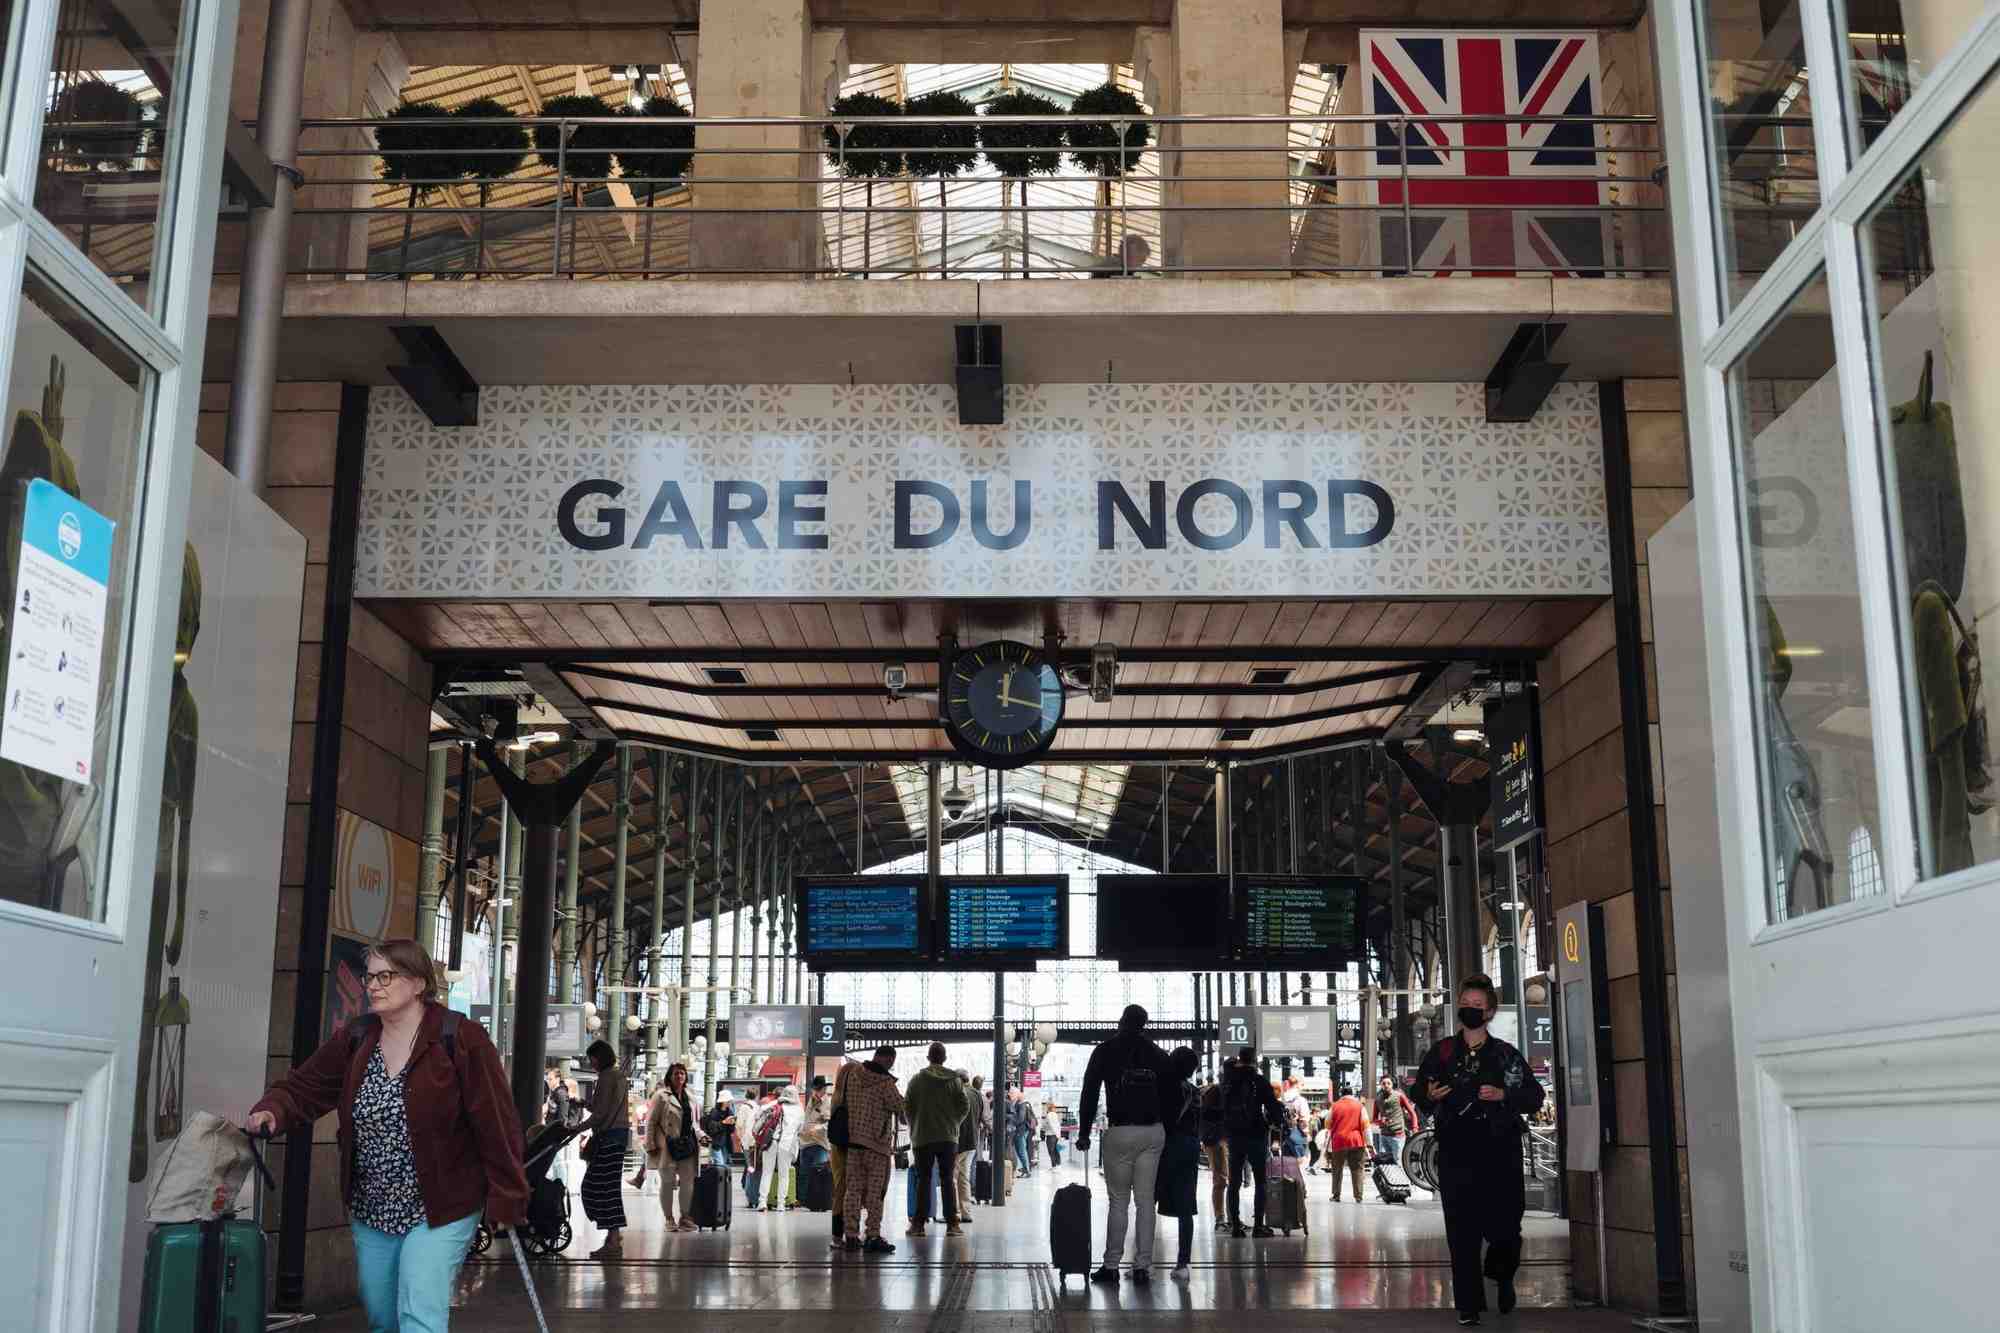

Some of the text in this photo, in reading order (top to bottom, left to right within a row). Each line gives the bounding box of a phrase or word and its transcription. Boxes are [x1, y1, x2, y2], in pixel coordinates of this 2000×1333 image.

[557, 478, 1394, 550] GARE DU NORD
[822, 1024, 833, 1041] 9
[1226, 1025, 1248, 1041] 10
